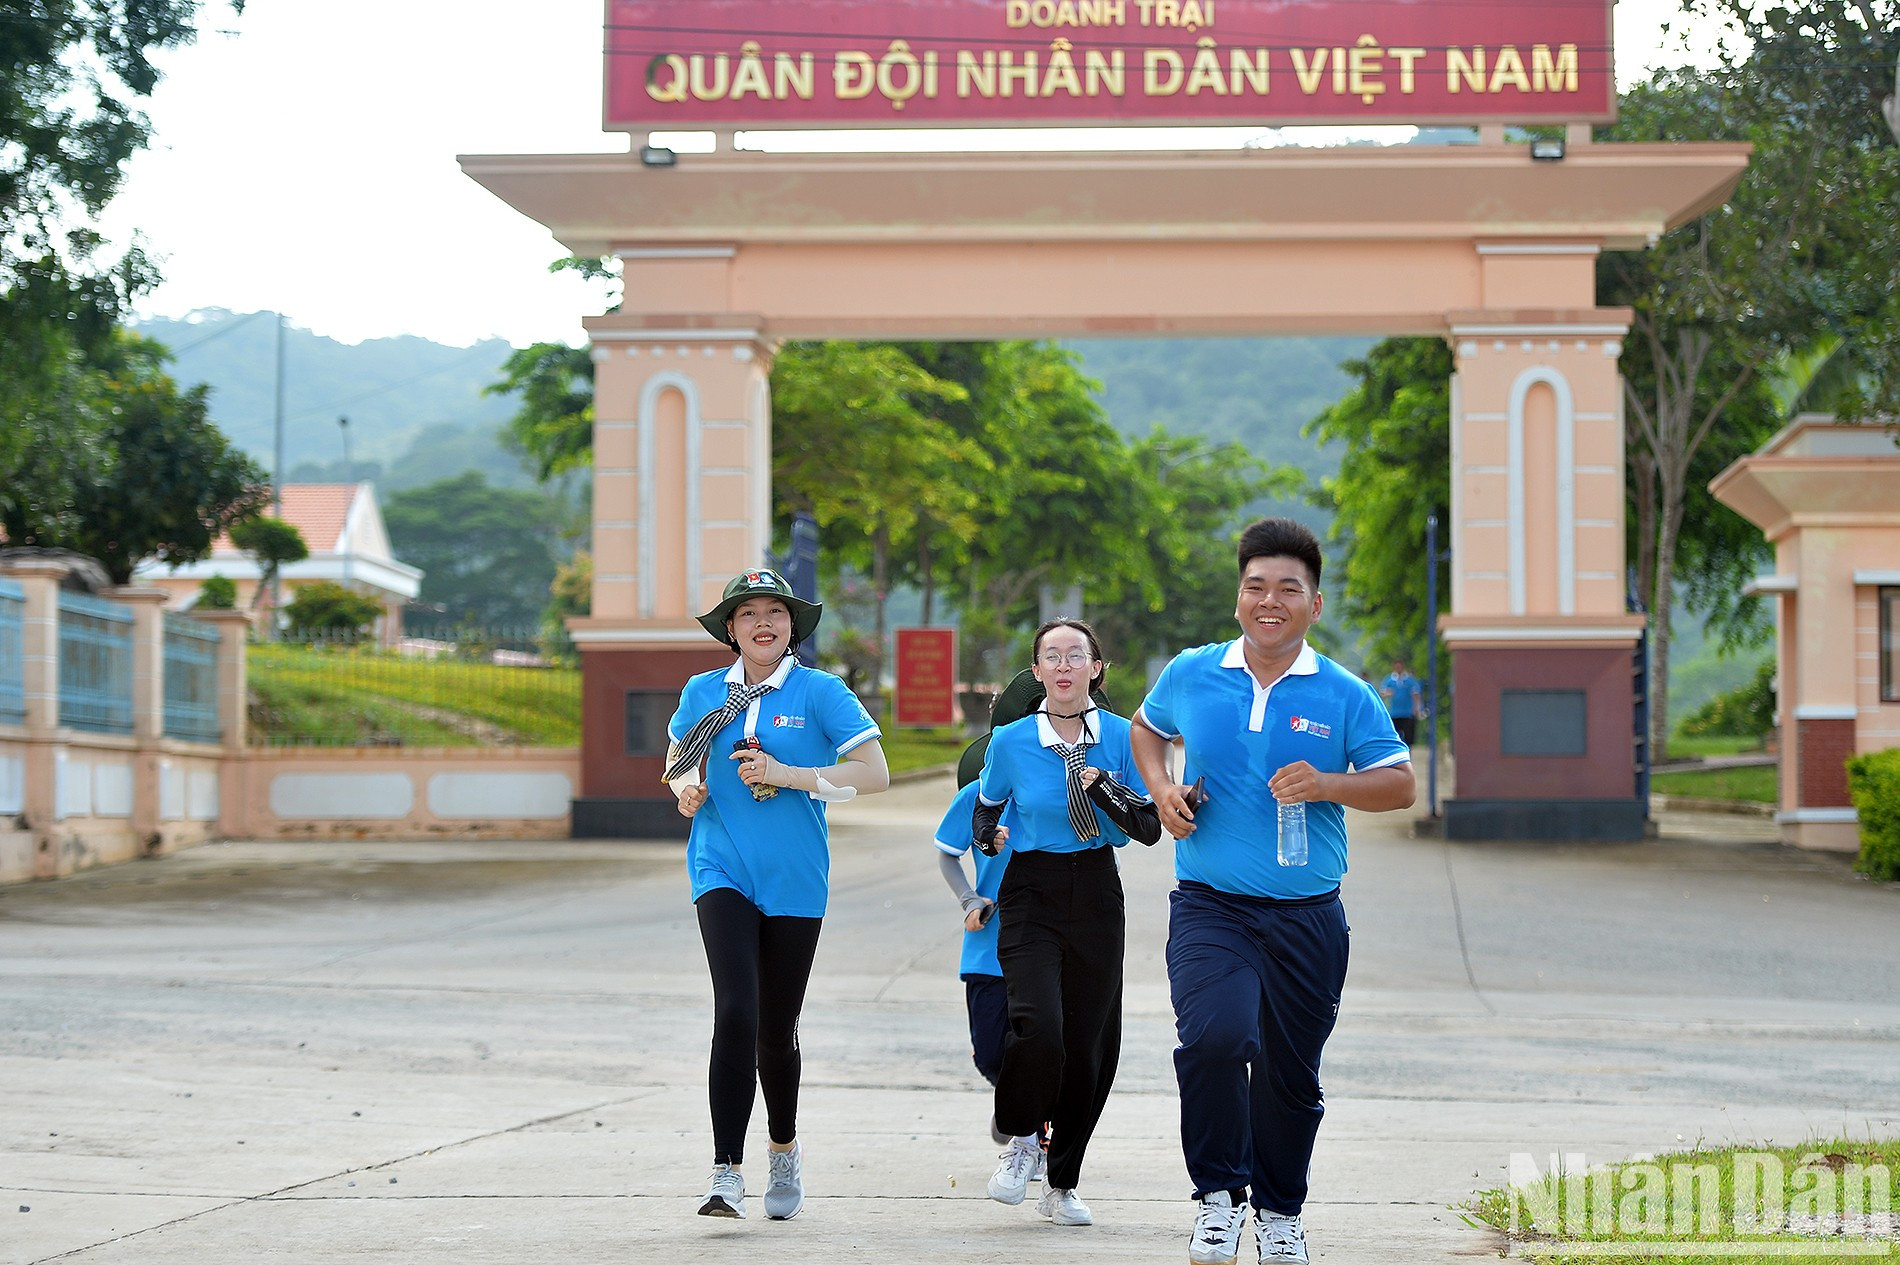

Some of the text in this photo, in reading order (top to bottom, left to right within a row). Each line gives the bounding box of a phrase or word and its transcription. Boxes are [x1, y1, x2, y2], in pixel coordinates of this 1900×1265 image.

[1006, 0, 1215, 33] DOANH TRẠI
[645, 34, 1579, 110] QUÂN ĐỘI NHÂN DÂN VIỆT NAM
